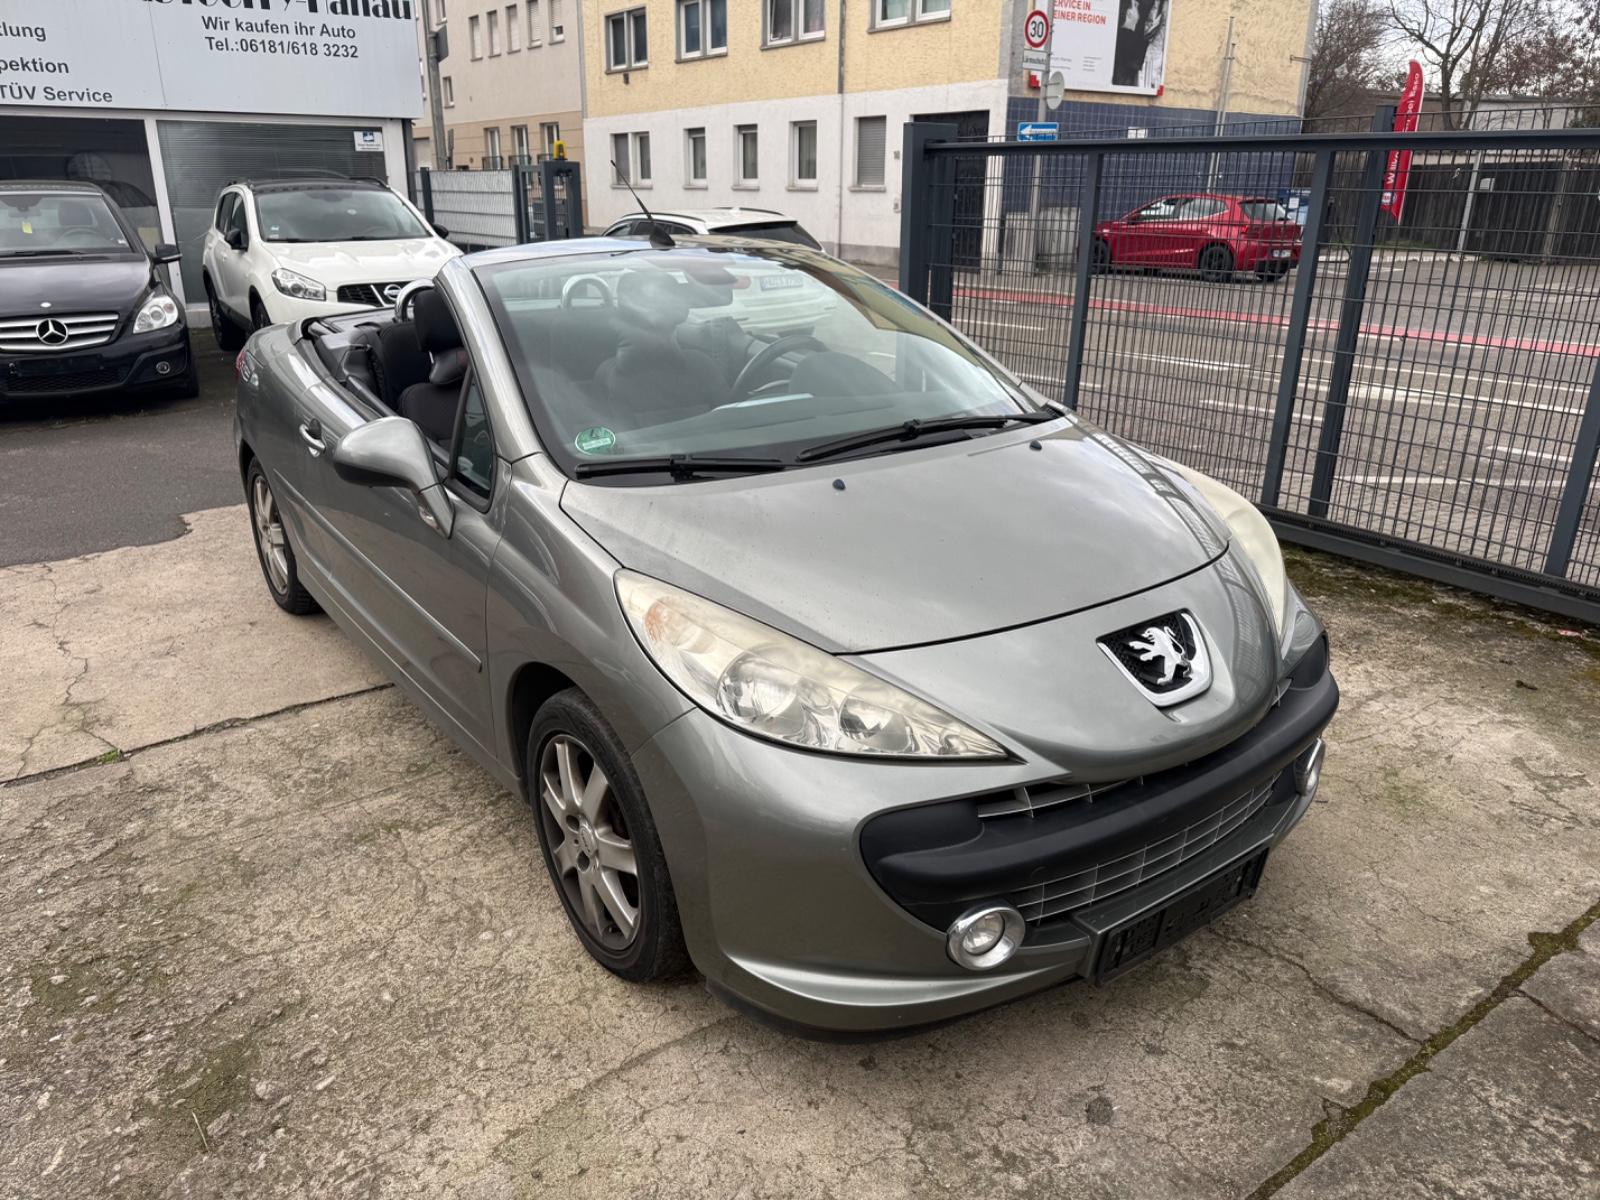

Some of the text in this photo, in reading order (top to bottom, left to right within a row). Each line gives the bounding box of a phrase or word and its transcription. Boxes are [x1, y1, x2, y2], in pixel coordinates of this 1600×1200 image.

[1053, 0, 1091, 11] ERVICE IN
[201, 15, 356, 39] Wir kaufen ihr Auto
[1053, 10, 1106, 25] EINER REGION
[1030, 21, 1044, 38] 30
[204, 36, 359, 58] Tel.:06181/618 3232
[0, 82, 113, 103] TÜV Service
